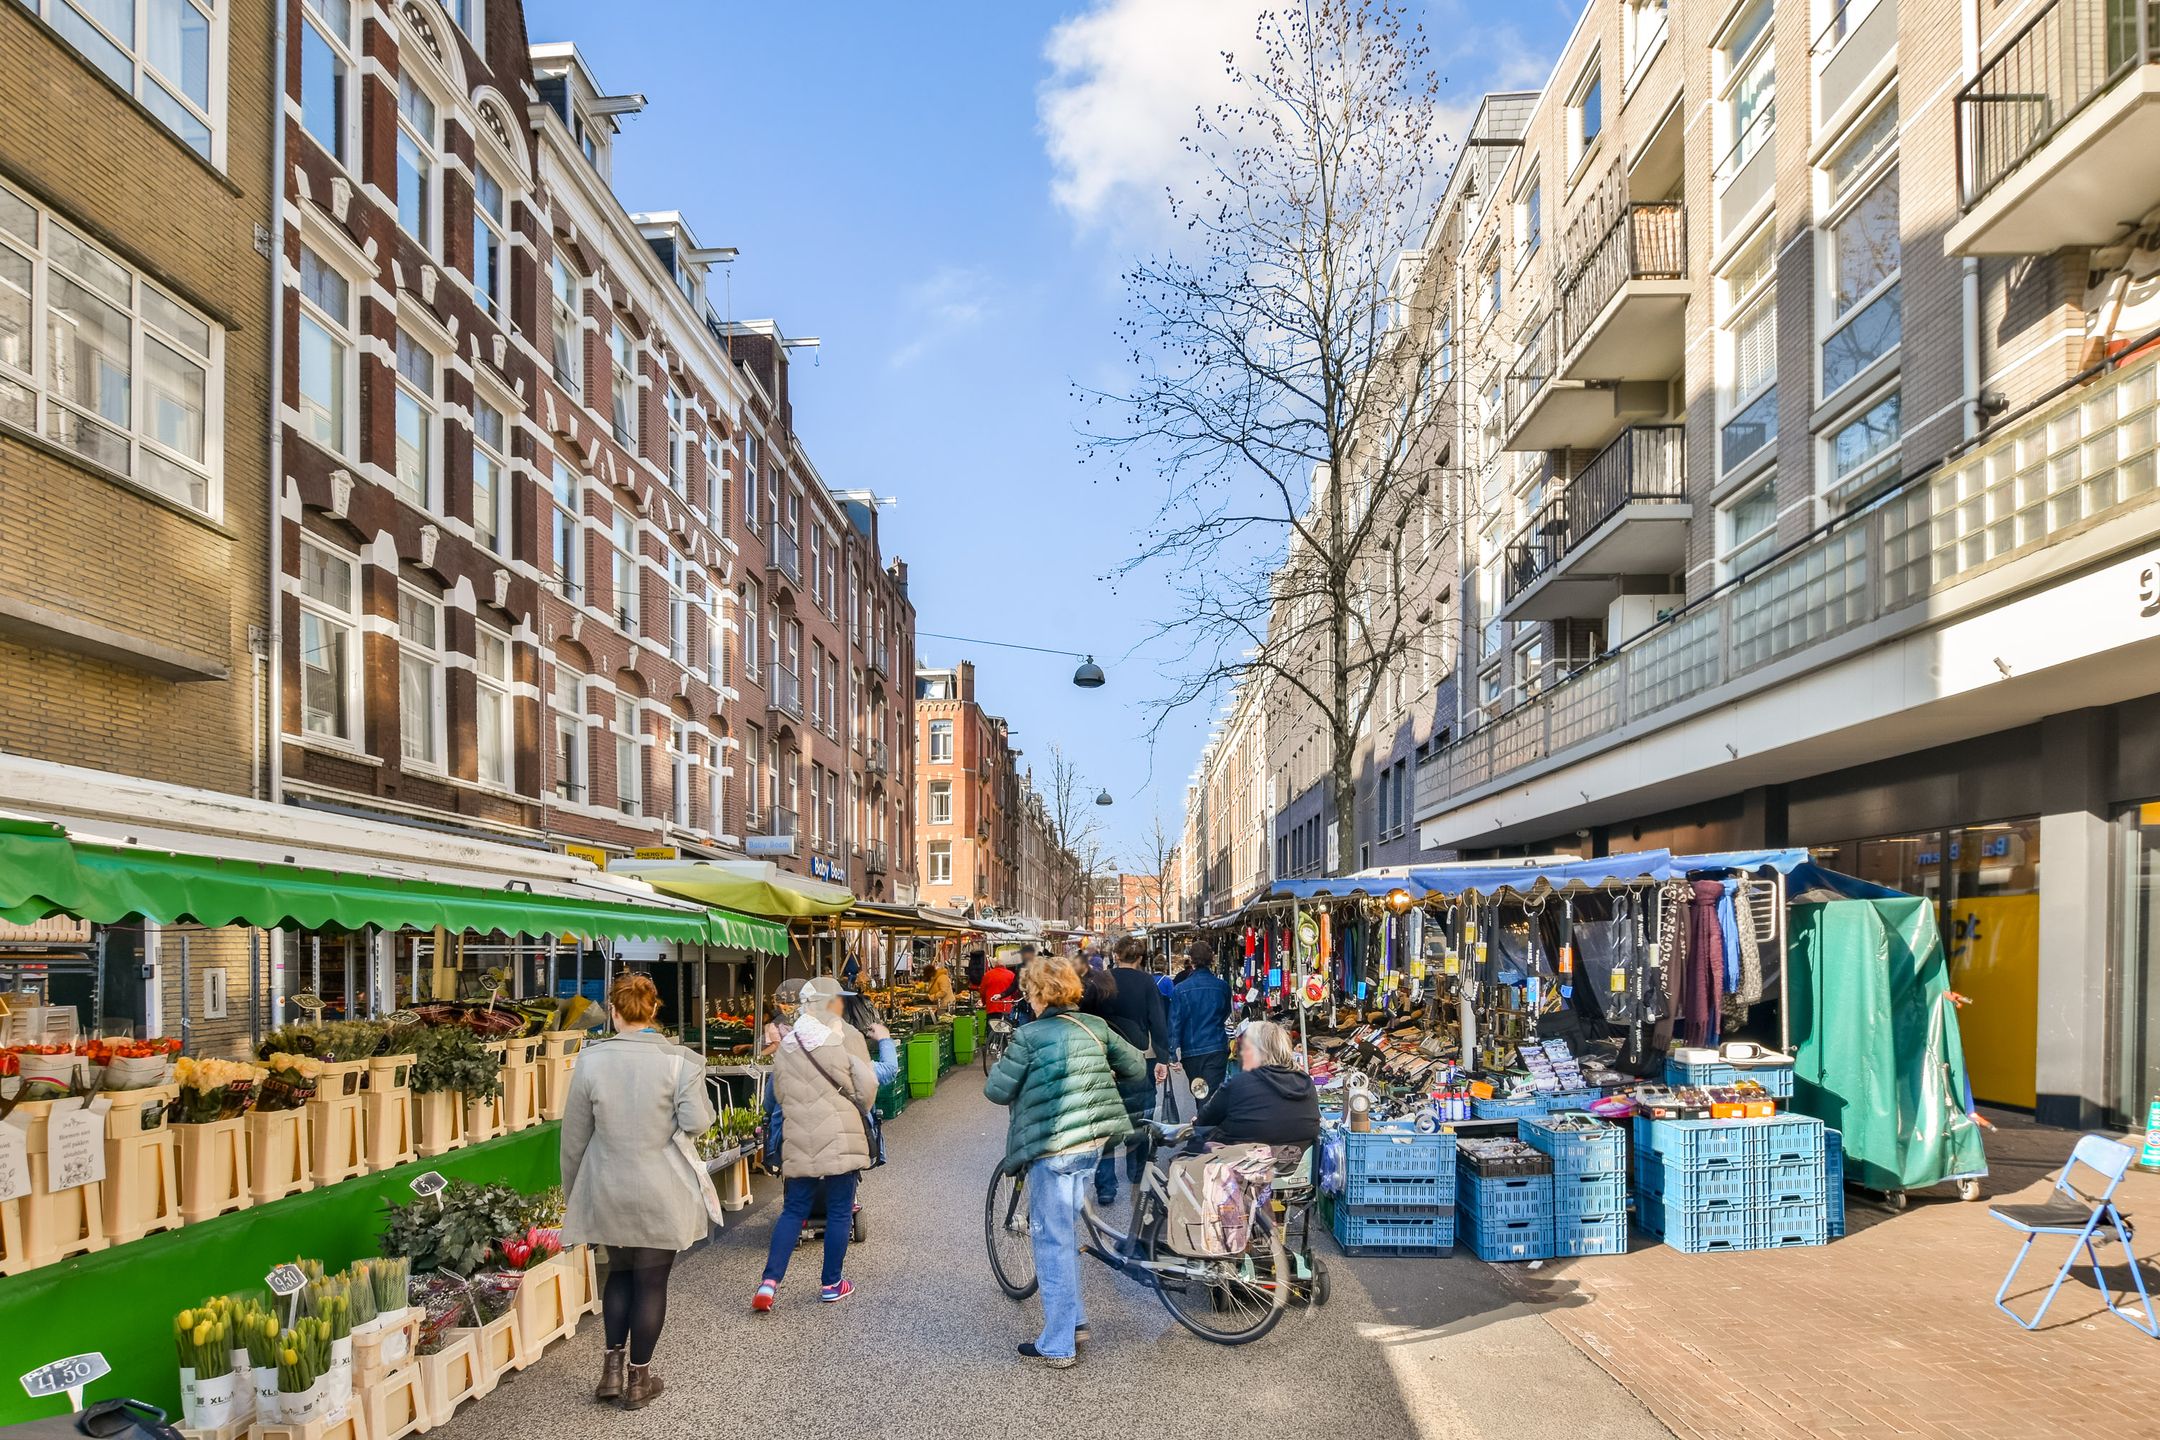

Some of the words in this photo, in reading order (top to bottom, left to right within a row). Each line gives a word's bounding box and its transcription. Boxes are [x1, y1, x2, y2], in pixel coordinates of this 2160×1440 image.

[812, 856, 829, 882] Baby
[38, 1362, 91, 1390] 4.50
[210, 1396, 224, 1405] XL
